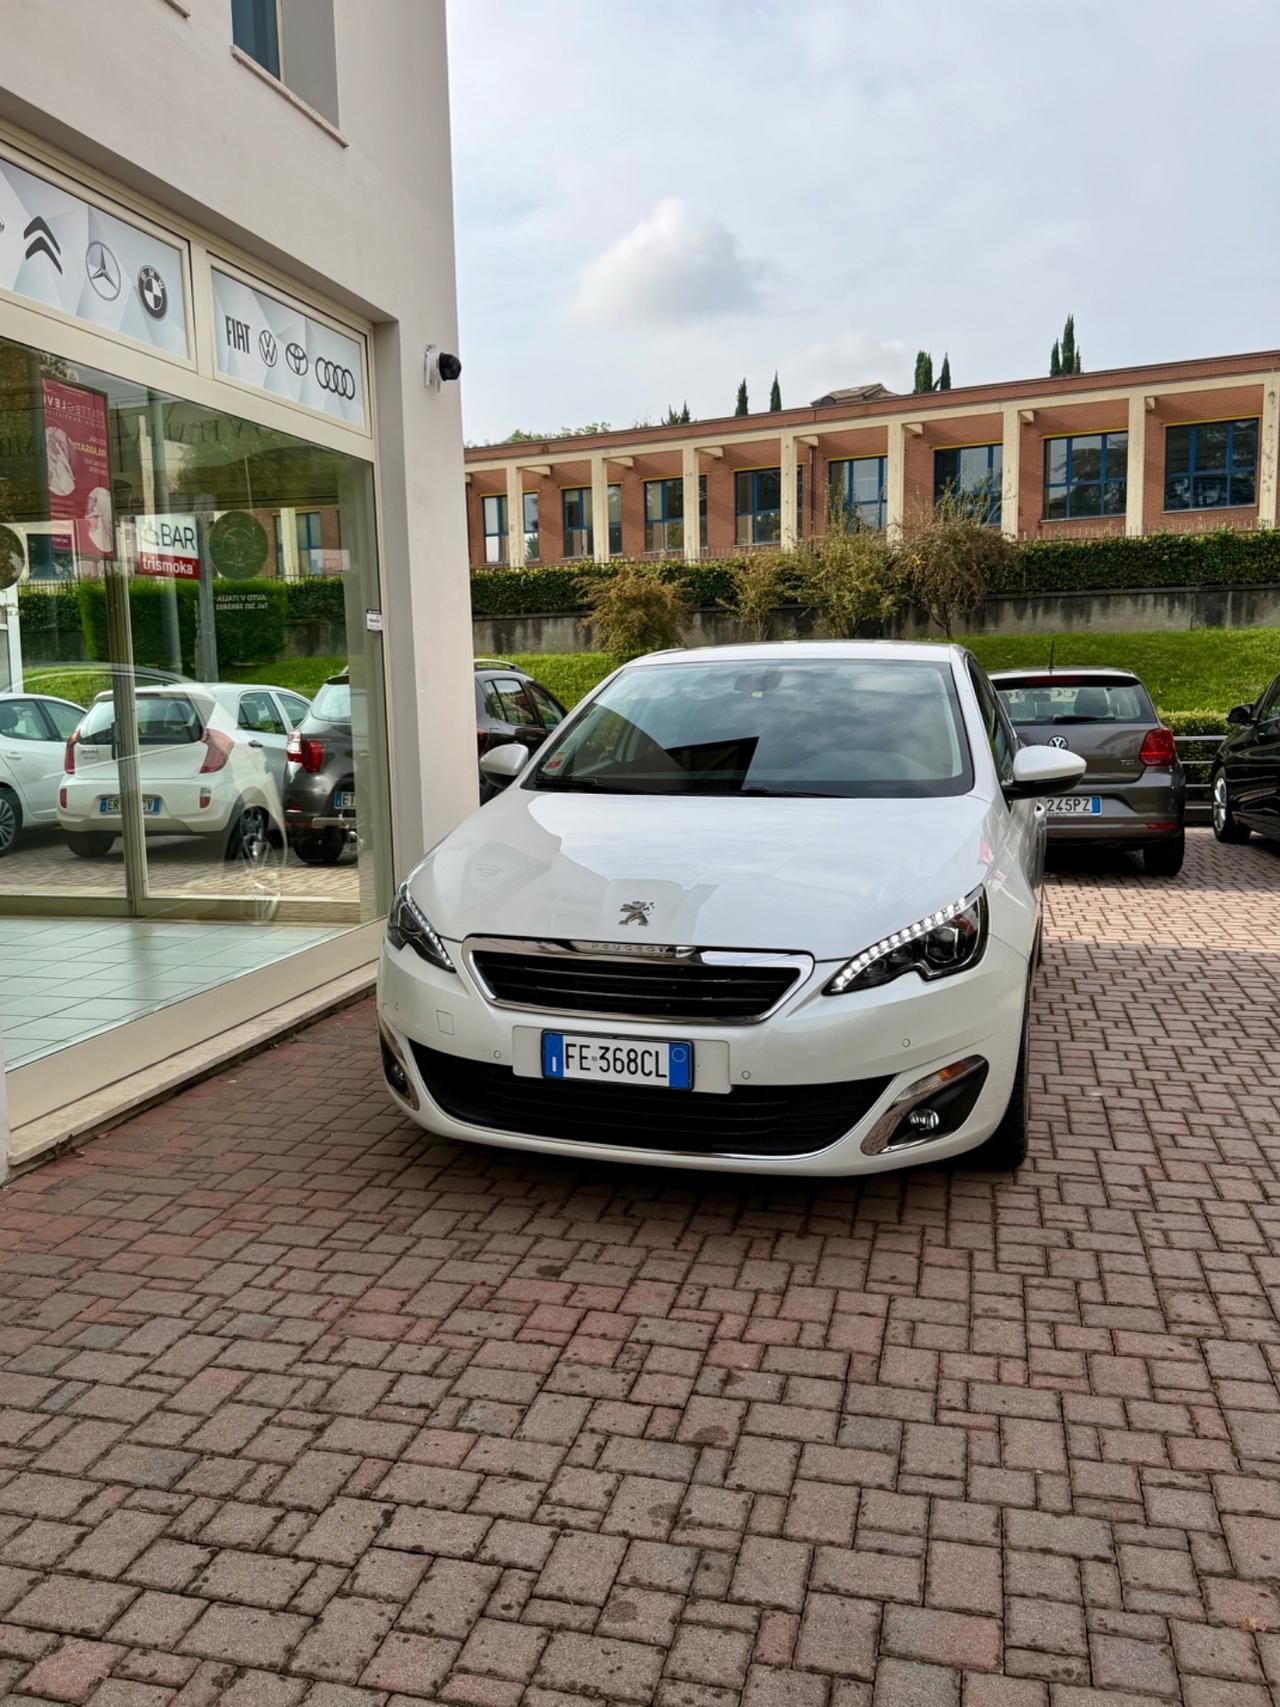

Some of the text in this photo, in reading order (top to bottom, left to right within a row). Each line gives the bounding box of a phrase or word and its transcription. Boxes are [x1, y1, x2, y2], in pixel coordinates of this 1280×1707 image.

[225, 315, 251, 354] FIAT
[161, 523, 196, 551] BAR
[143, 556, 194, 575] trismoka
[1046, 799, 1091, 812] 245PZ
[591, 942, 667, 954] PEUGEOT
[564, 1043, 668, 1079] FE368CL
